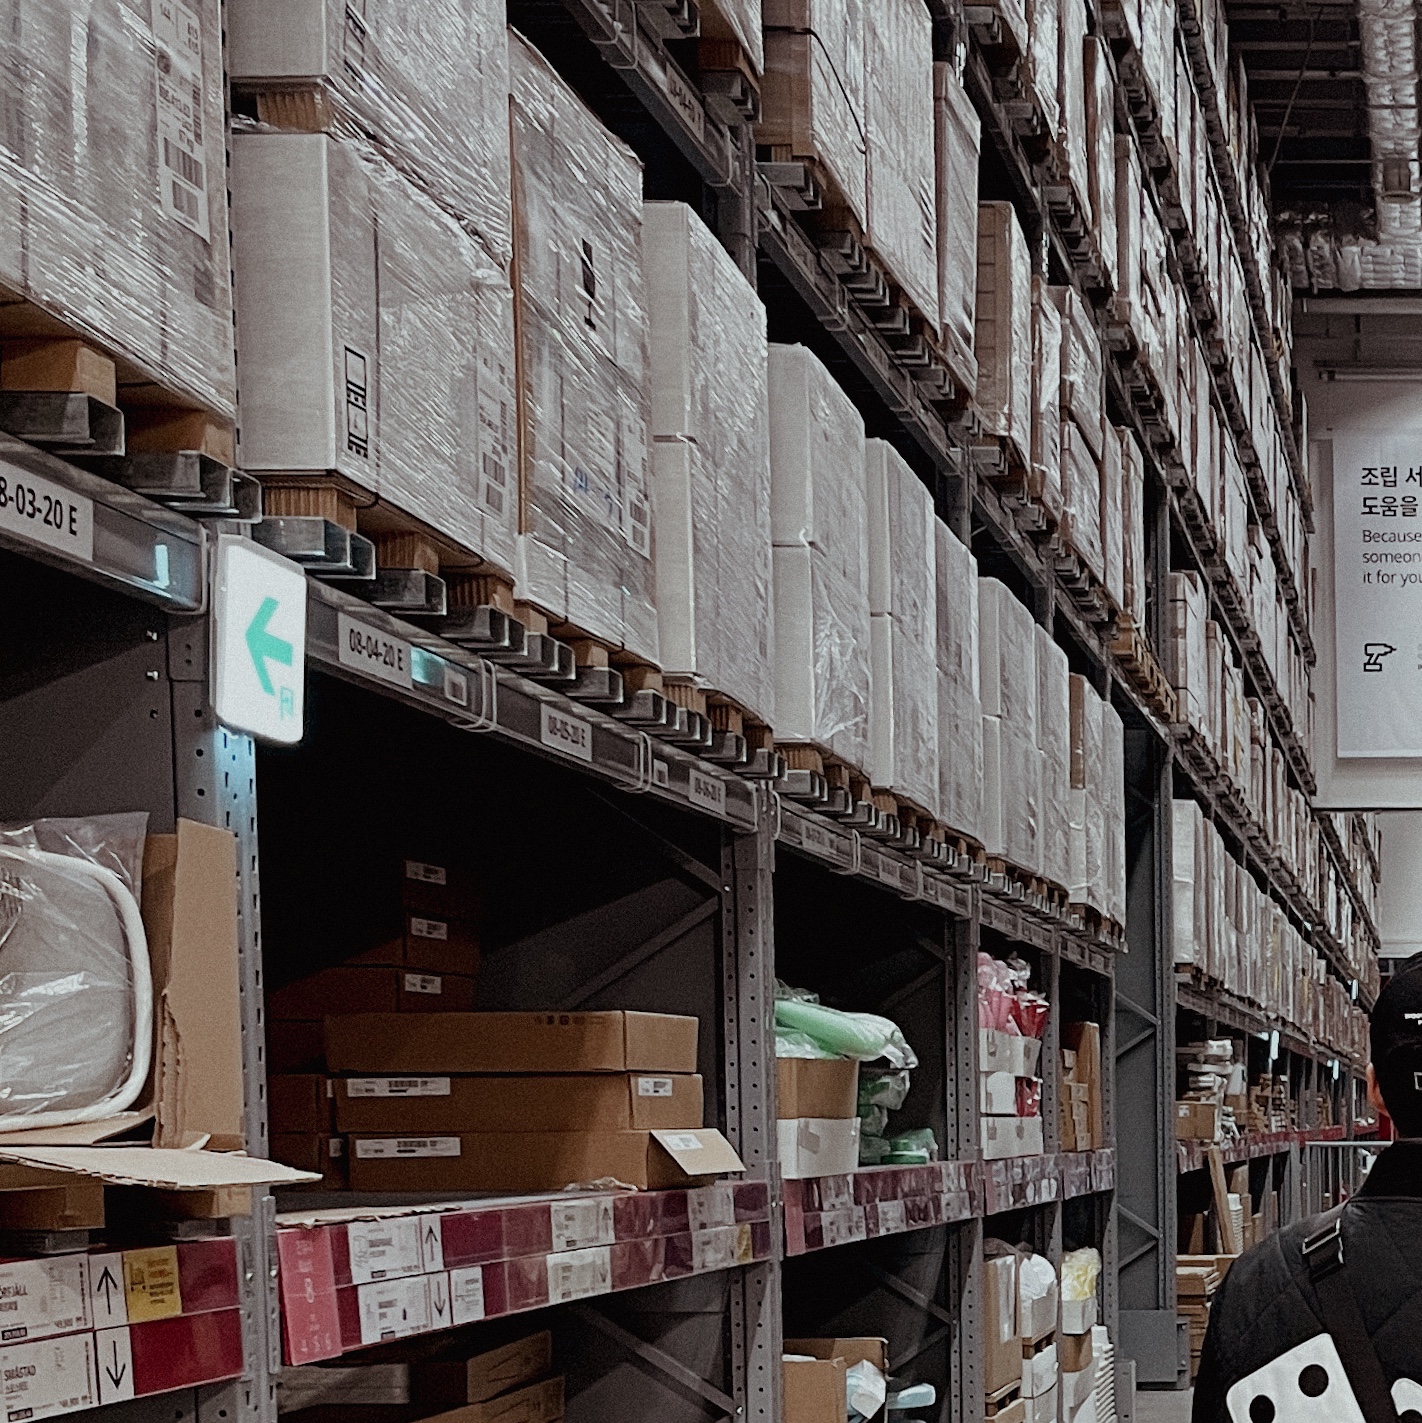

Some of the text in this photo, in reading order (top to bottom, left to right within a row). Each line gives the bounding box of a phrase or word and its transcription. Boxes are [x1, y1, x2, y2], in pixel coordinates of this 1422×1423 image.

[1360, 465, 1398, 488] 조립
[1360, 495, 1419, 517] 도움을
[69, 504, 78, 536] E
[1362, 529, 1422, 543] Because
[1363, 571, 1372, 584] it
[1376, 569, 1396, 584] for
[398, 648, 403, 671] E
[304, 1278, 315, 1303] 8
